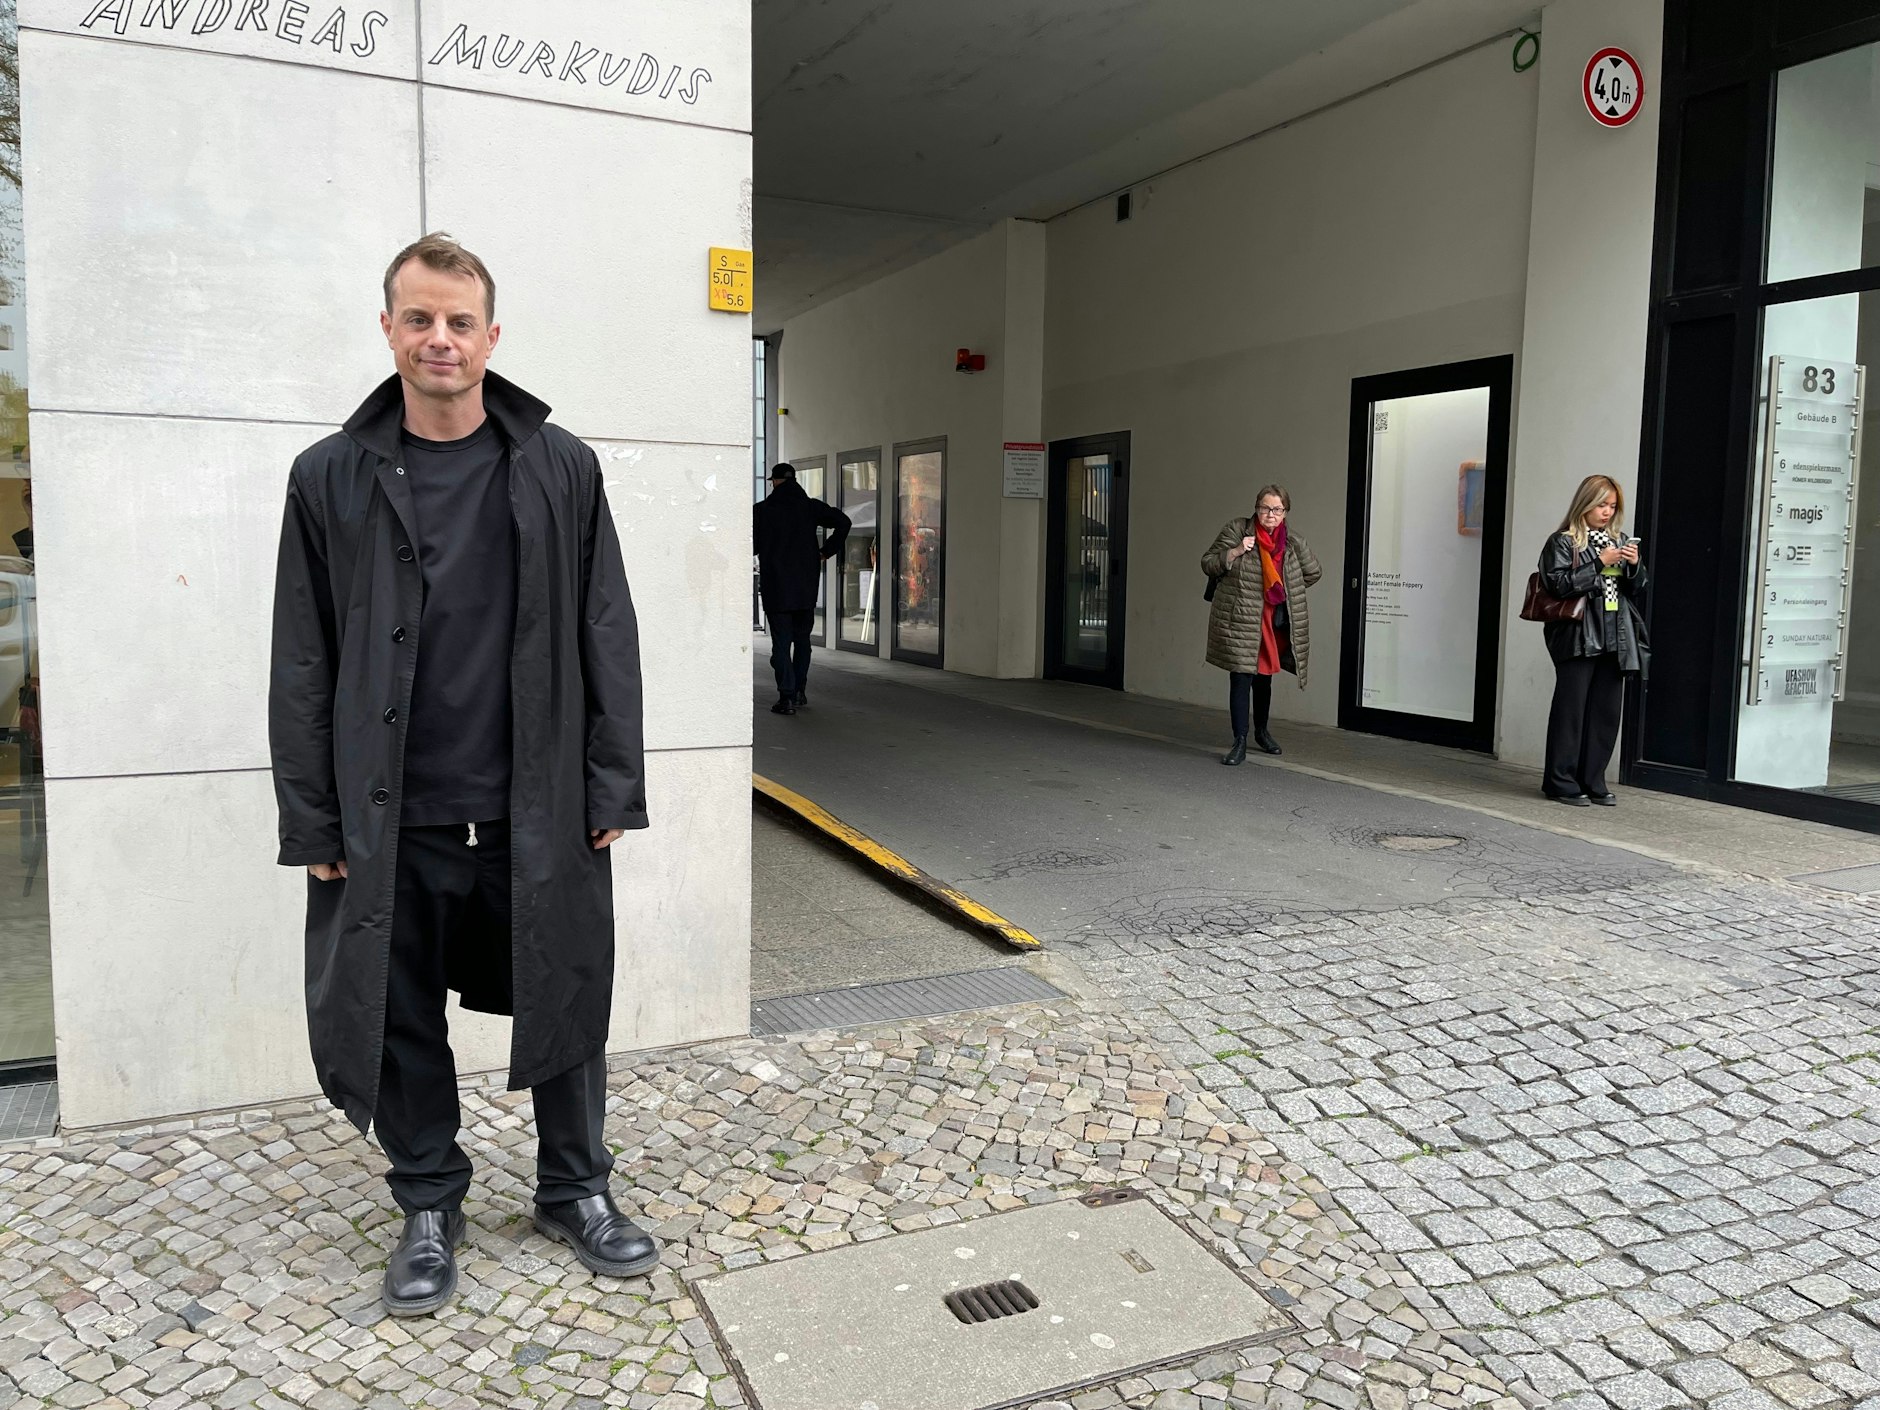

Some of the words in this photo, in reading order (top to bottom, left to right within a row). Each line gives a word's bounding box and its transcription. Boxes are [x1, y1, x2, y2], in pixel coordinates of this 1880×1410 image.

[79, 0, 388, 58] ANDREAS
[428, 23, 712, 105] MURKUDIS
[721, 255, 727, 267] S
[1802, 365, 1835, 395] 83
[1797, 412, 1830, 423] Gebäude
[1831, 415, 1837, 424] B
[1779, 458, 1786, 469] 6
[1776, 503, 1783, 514] 5
[1789, 505, 1823, 524] magis
[1773, 547, 1780, 558] 4
[1383, 580, 1402, 588] Female
[1770, 591, 1777, 602] 3
[1783, 598, 1828, 606] Personaleingang
[1767, 635, 1774, 645] 2
[1782, 634, 1806, 642] SUNDAY
[1806, 634, 1833, 642] NATURAL
[1764, 679, 1769, 688] 1
